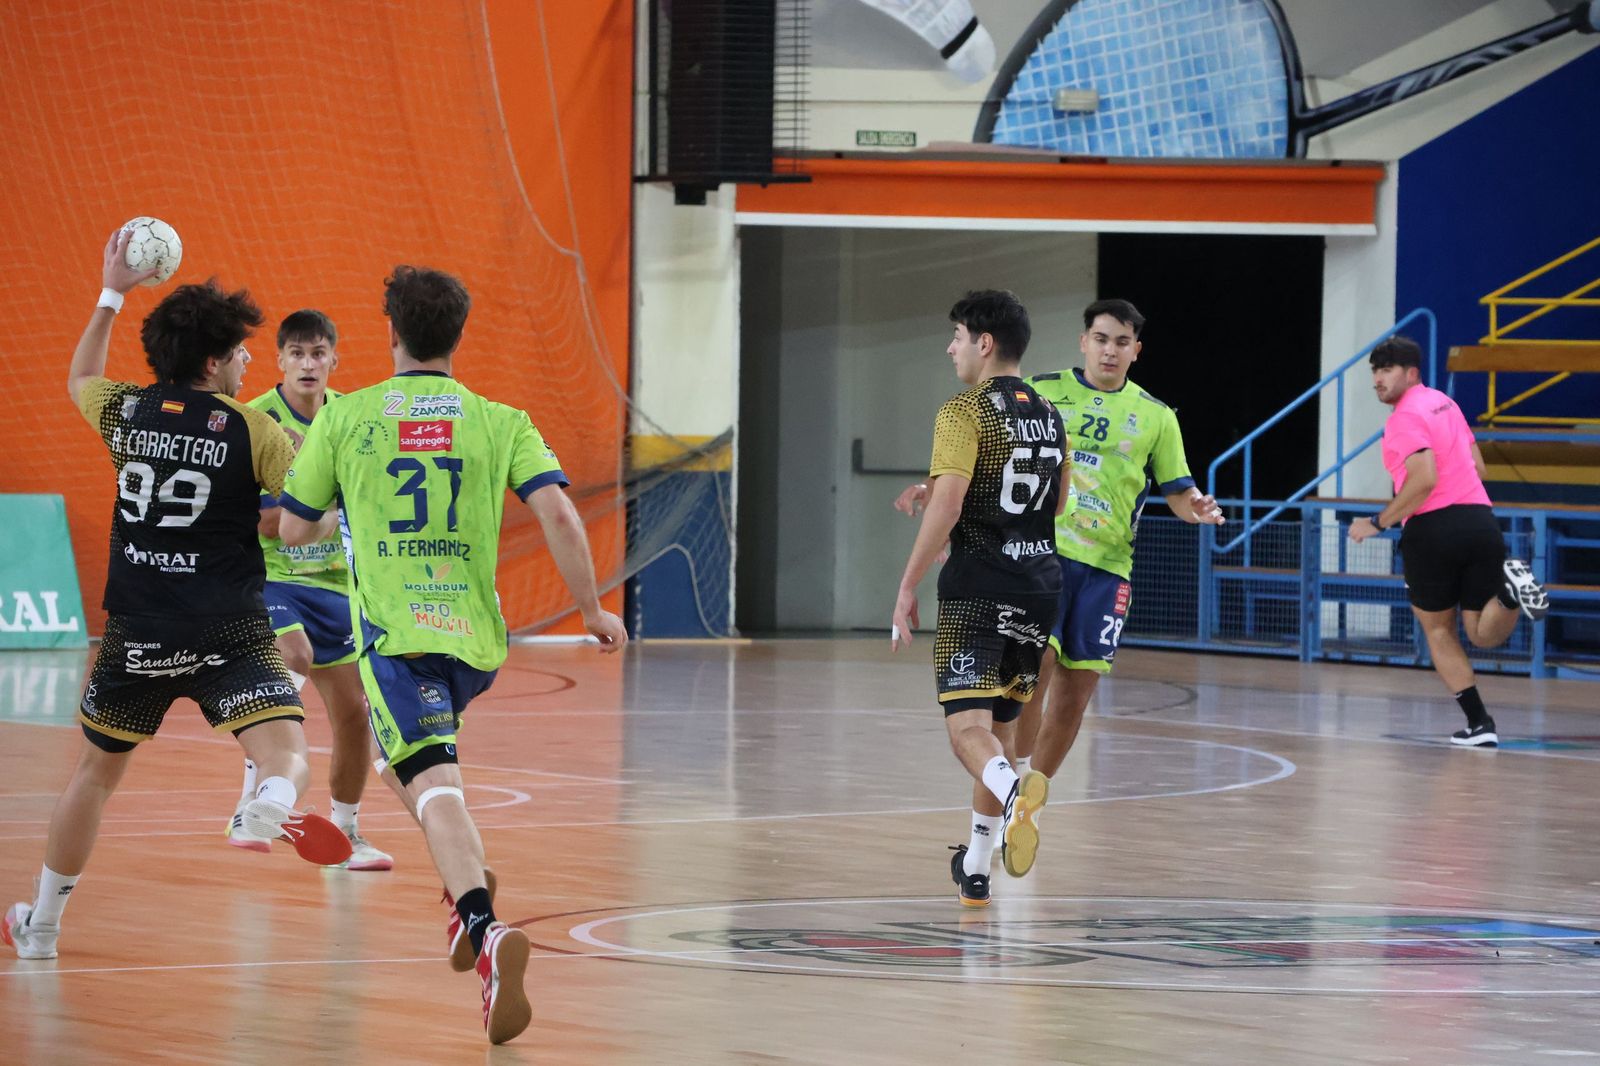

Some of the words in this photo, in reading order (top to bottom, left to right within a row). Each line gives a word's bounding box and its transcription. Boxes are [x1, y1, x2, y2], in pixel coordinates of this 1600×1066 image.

[1078, 413, 1110, 442] 28
[126, 429, 228, 468] CARRETERO
[1073, 450, 1098, 466] gaza
[118, 461, 212, 527] 99
[1000, 446, 1063, 515] 67
[386, 457, 463, 534] 37
[377, 540, 393, 557] A.
[404, 583, 469, 591] MOLENDUM
[409, 603, 450, 618] PRO
[124, 641, 161, 649] AUTOCARES
[1099, 614, 1124, 647] 28
[125, 649, 198, 669] Sanalón
[218, 686, 293, 718] GUINALDO
